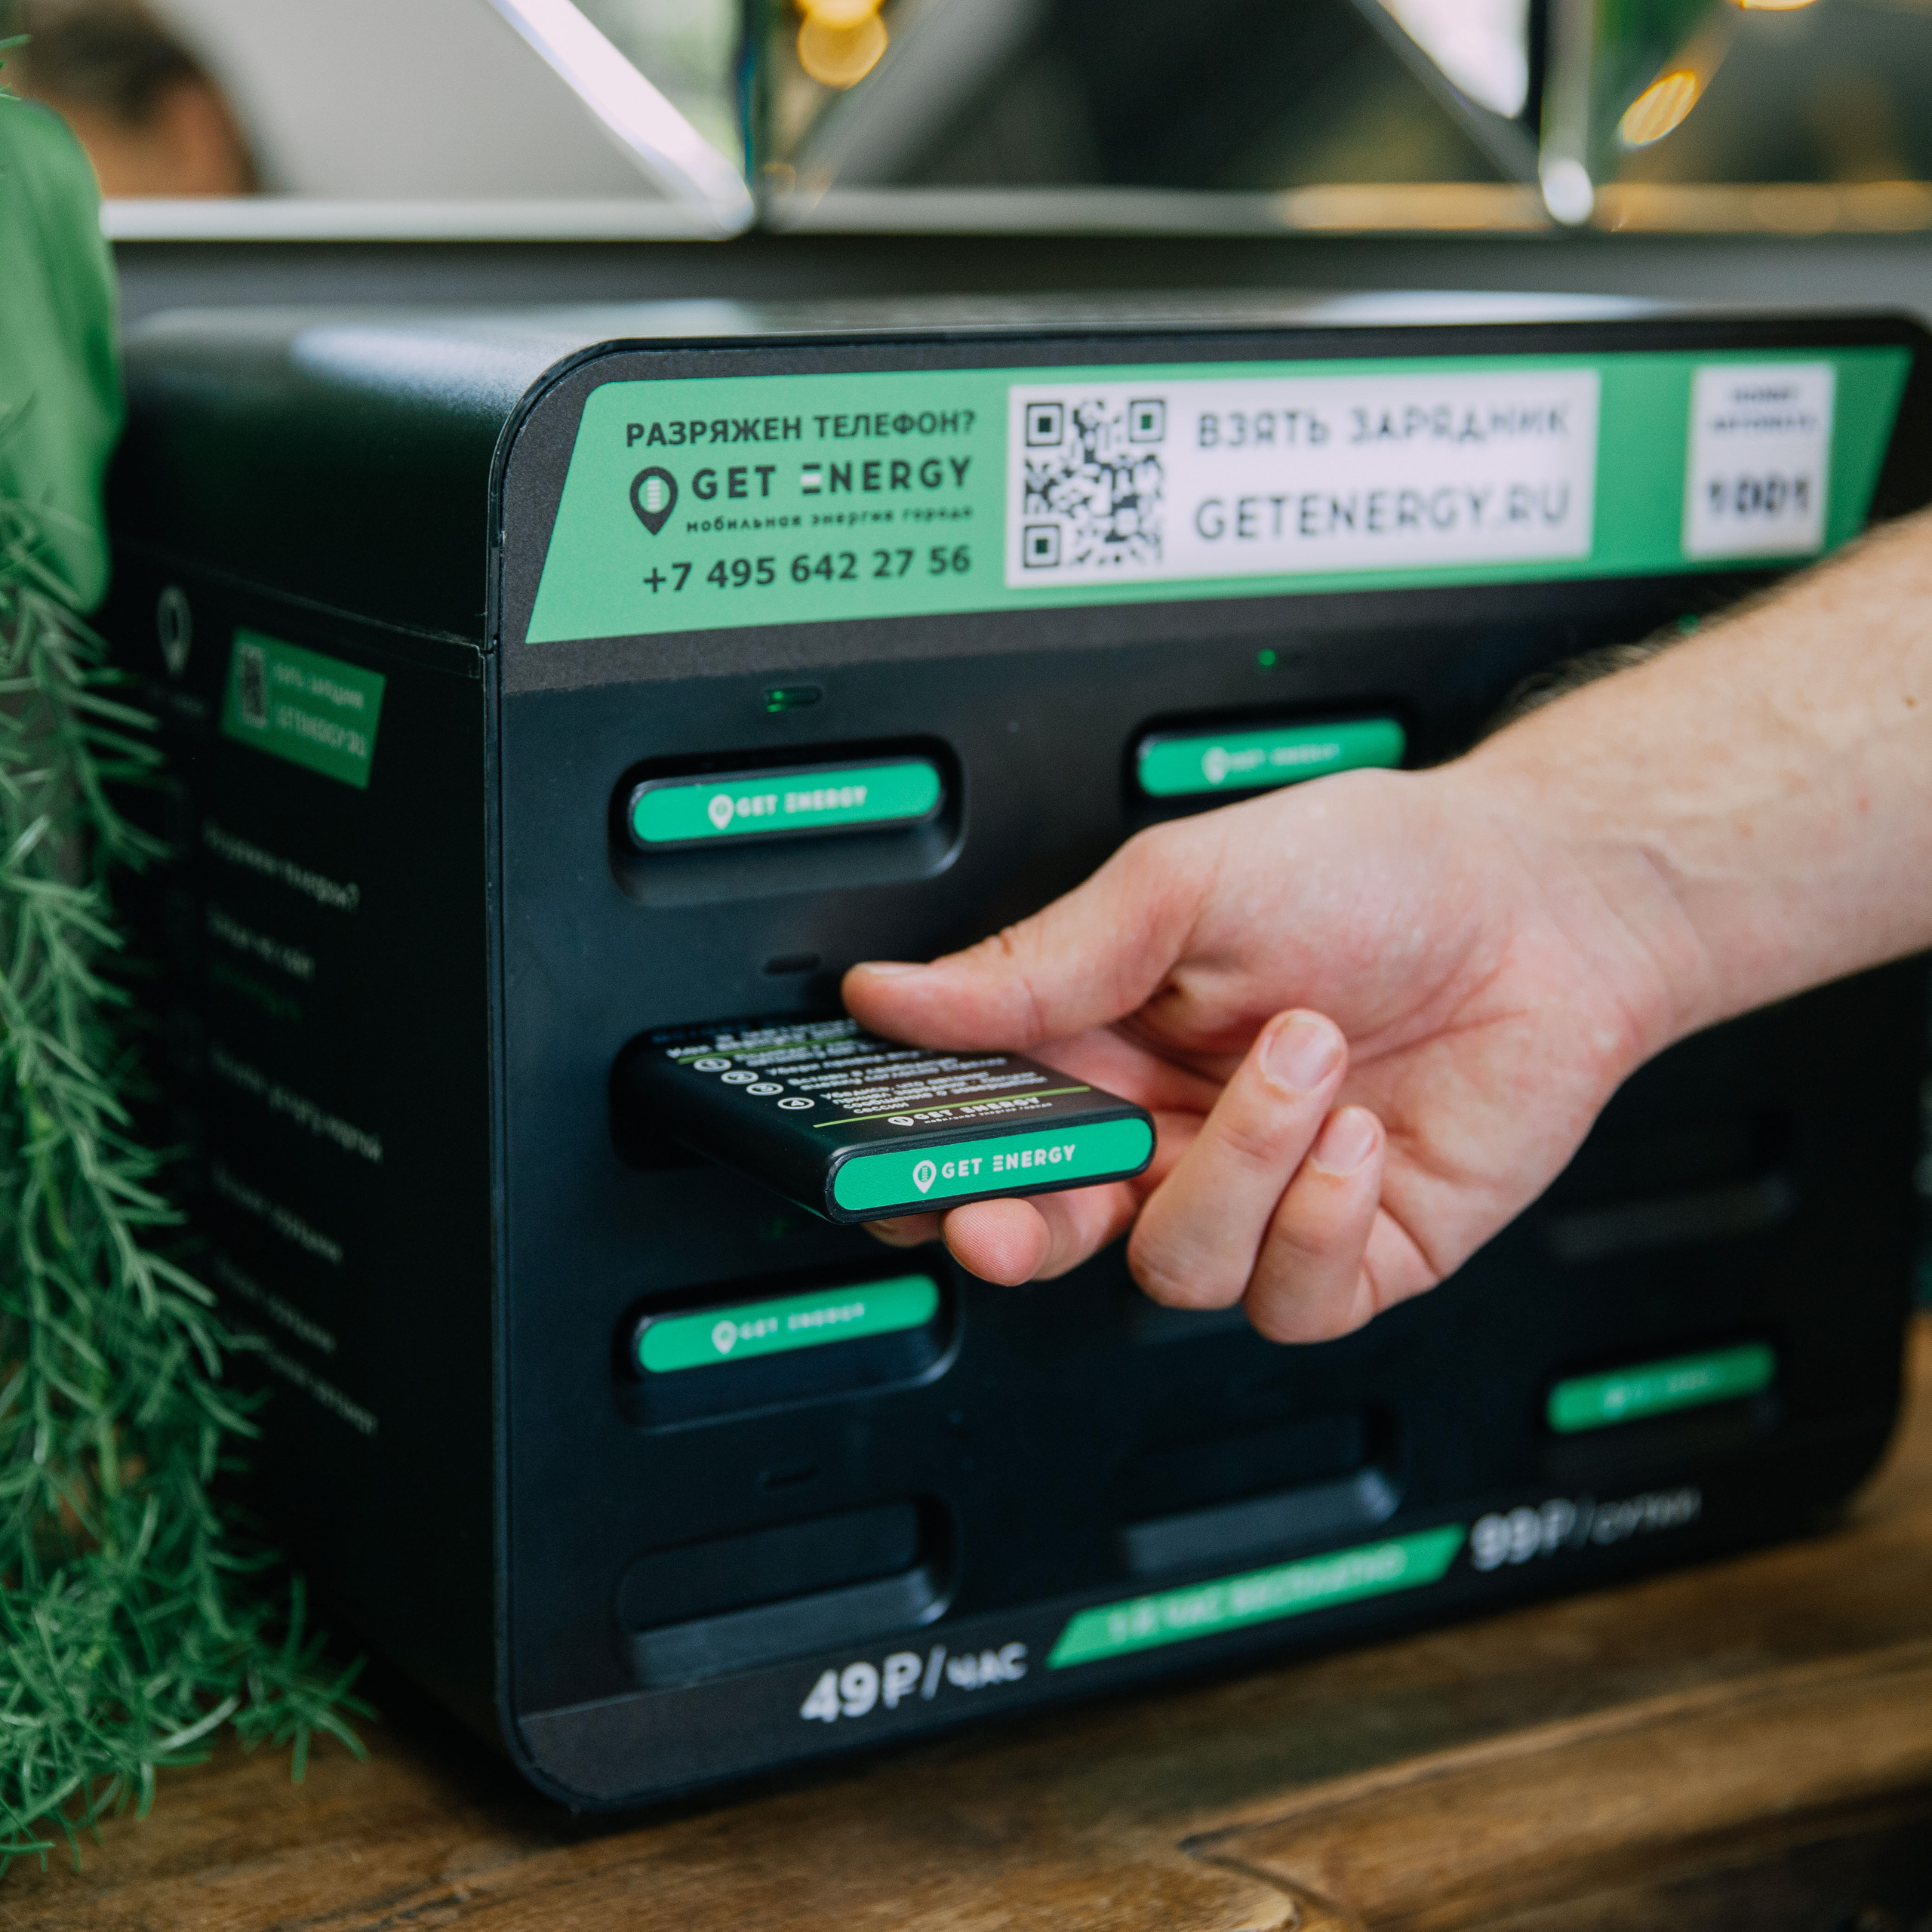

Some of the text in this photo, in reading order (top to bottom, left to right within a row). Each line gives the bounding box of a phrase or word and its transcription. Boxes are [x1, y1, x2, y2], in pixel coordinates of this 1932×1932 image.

[626, 410, 976, 447] РАЗРЯЖЕН ТЕЛЕФОН?
[1198, 401, 1570, 448] ВЗЯТЬ ЗАРЯДНИК
[692, 456, 972, 500] GET ENERGY
[687, 514, 801, 533] мобильная
[1194, 480, 1571, 540] GETENERGY.RU
[643, 544, 971, 593] +7 495 642 27 56
[736, 785, 868, 817] GET ENERGY
[914, 1109, 953, 1120] GET
[941, 1144, 1076, 1179] GET ENERGY
